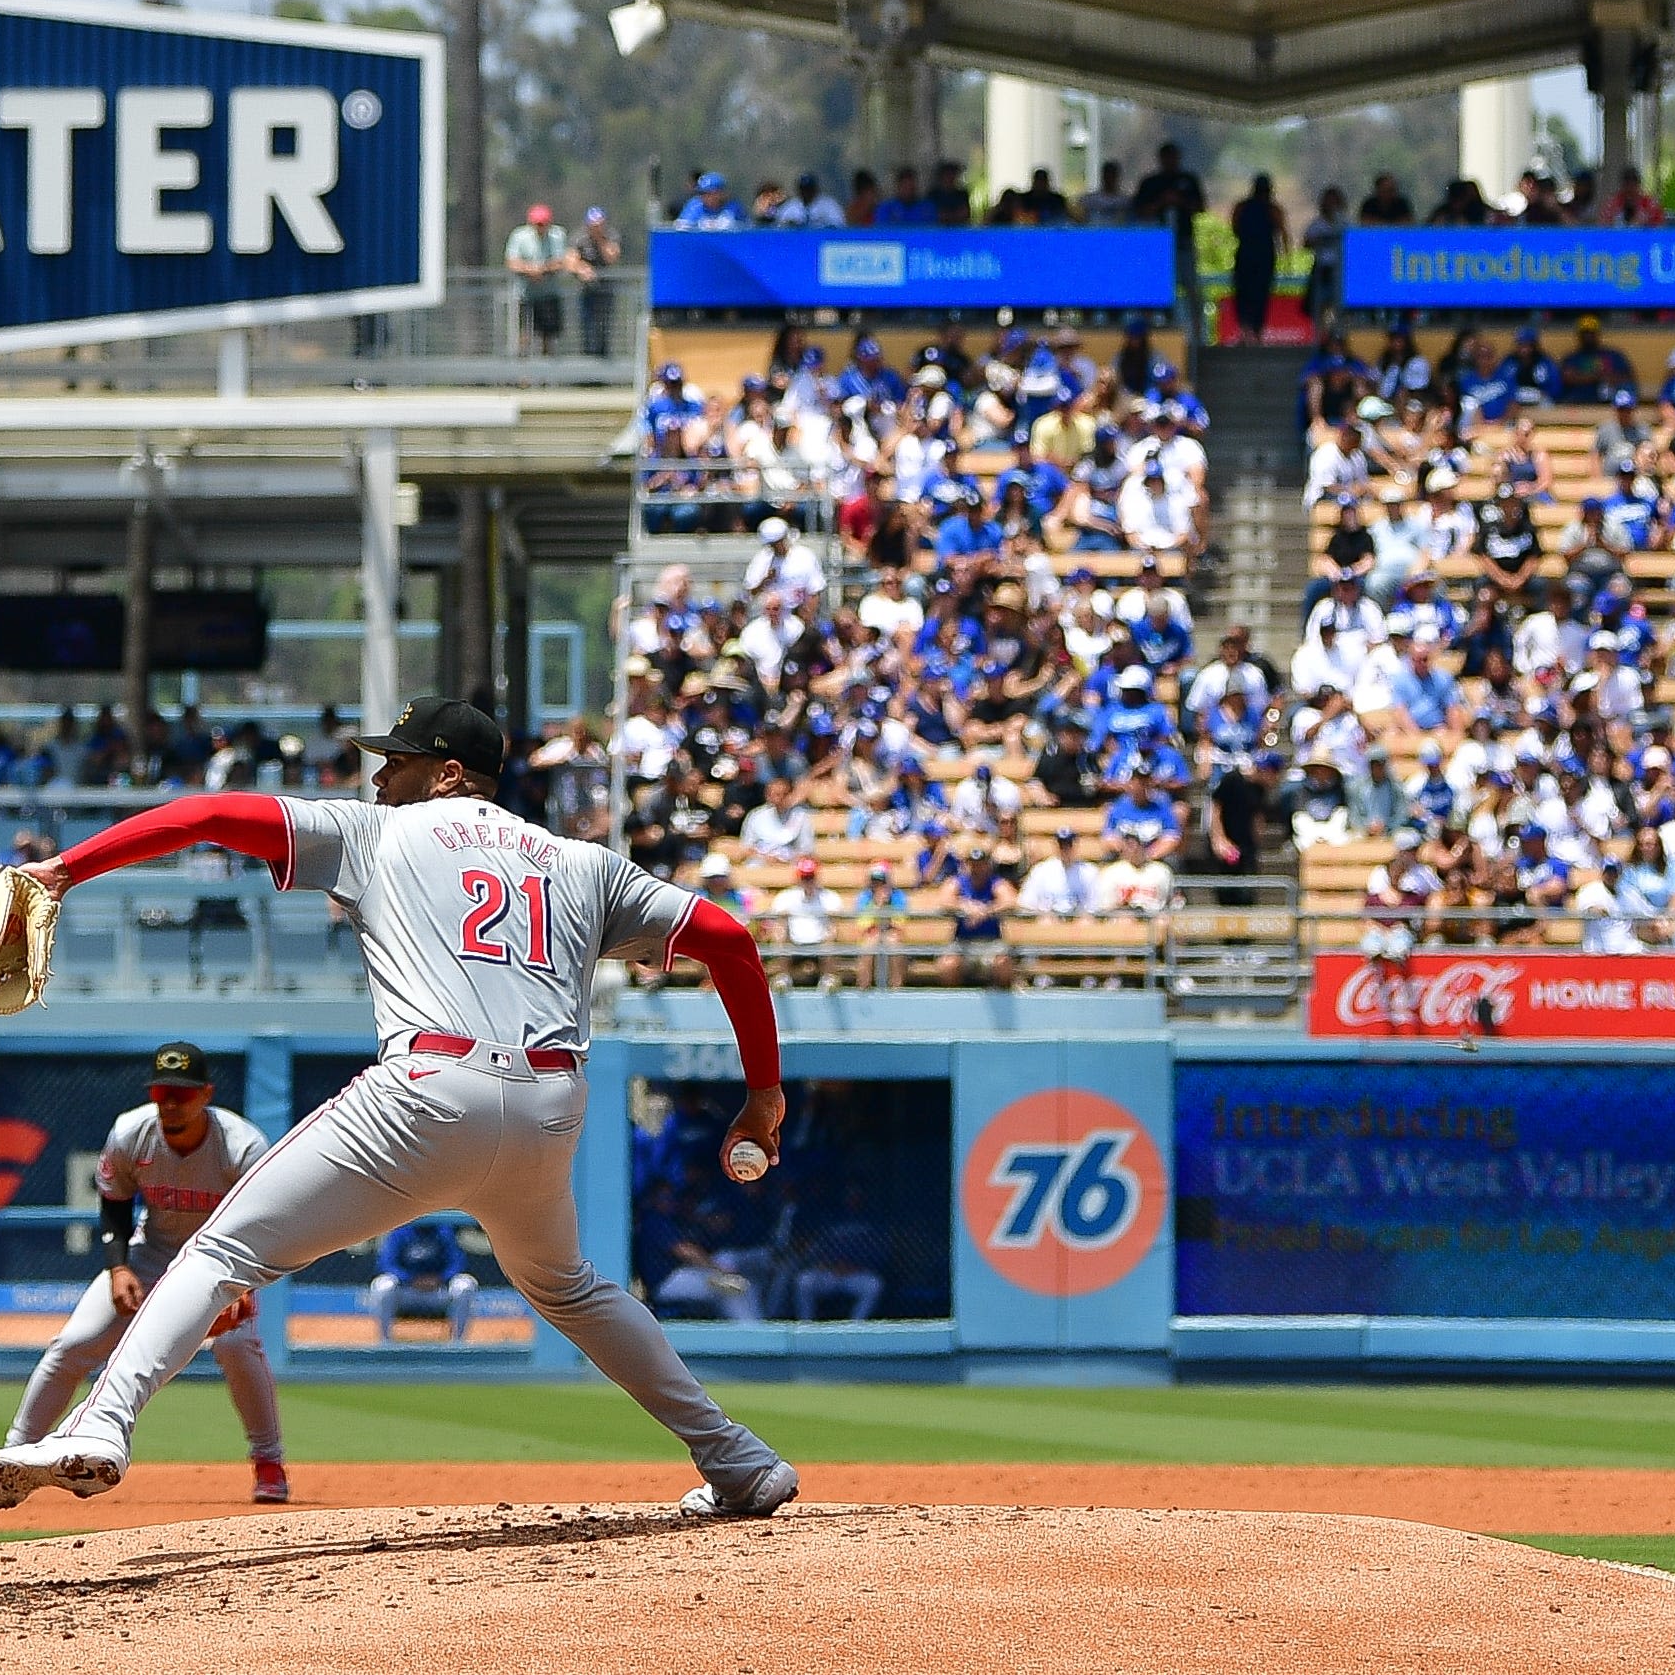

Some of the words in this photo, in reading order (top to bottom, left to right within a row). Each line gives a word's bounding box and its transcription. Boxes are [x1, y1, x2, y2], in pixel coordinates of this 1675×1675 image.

[1391, 243, 1640, 290] Introducing
[433, 822, 561, 870] GREENE
[457, 865, 558, 975] 21
[1530, 980, 1633, 1010] HOME
[1213, 1096, 1518, 1149] Introducing
[987, 1128, 1138, 1249] 76
[1213, 1148, 1359, 1198] UCLA
[1367, 1150, 1508, 1198] West
[1518, 1153, 1675, 1208] Valley
